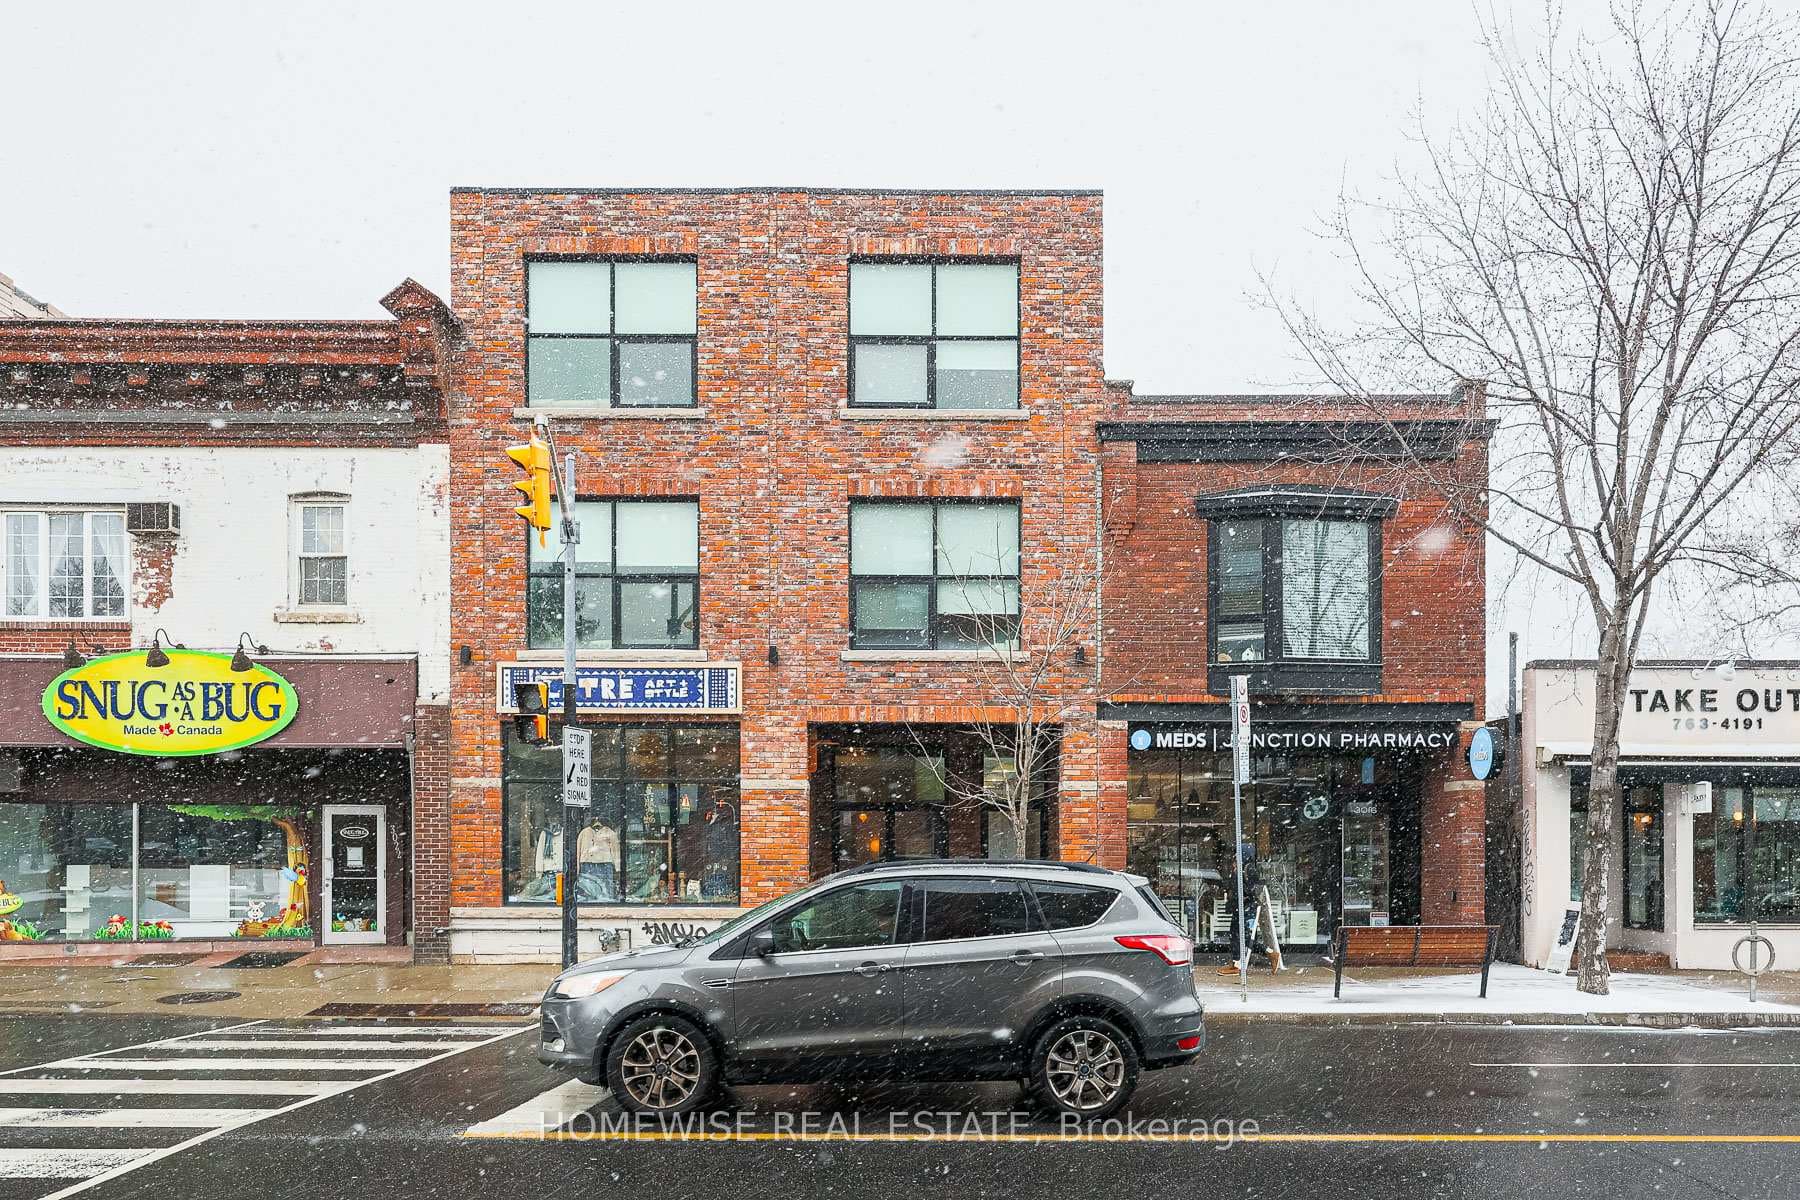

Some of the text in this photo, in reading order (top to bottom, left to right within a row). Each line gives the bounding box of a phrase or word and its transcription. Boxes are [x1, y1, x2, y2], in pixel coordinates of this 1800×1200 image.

[644, 679, 674, 689] ART
[644, 688, 689, 698] STYLE
[57, 679, 168, 721] SNUG
[171, 681, 196, 701] AS
[200, 682, 282, 722] BUG
[1629, 689, 1718, 713] TAKE
[1673, 717, 1763, 730] 763-4191
[123, 725, 157, 736] Made
[177, 725, 222, 736] Canada
[569, 733, 585, 745] STOP
[1156, 732, 1207, 748] MEDS
[1340, 733, 1454, 748] PHARMACY
[569, 747, 585, 759] HERE
[580, 762, 589, 773] ON
[576, 776, 588, 787] RED
[567, 789, 588, 801] SIGNAL
